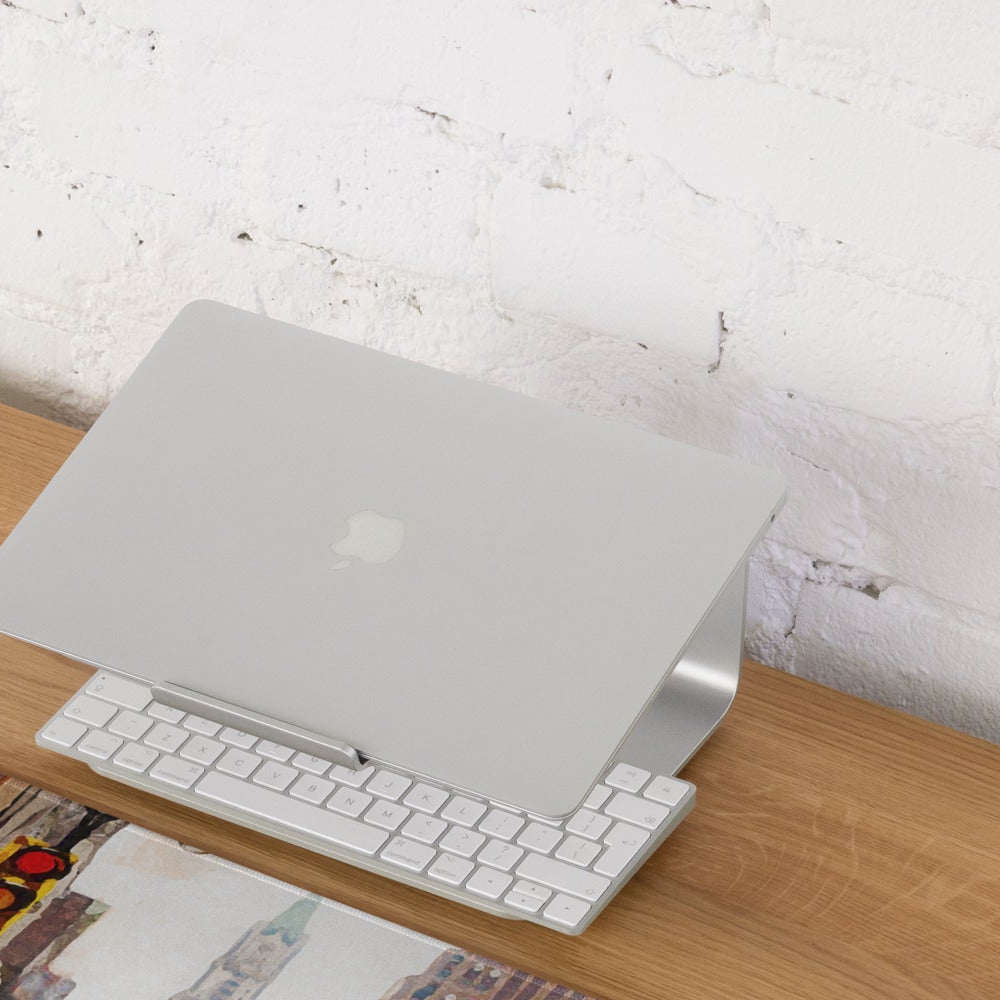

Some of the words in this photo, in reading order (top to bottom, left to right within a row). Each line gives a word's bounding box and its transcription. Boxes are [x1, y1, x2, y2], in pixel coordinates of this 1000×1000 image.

[156, 768, 190, 783] command
[385, 850, 421, 866] command
[433, 867, 457, 879] option
